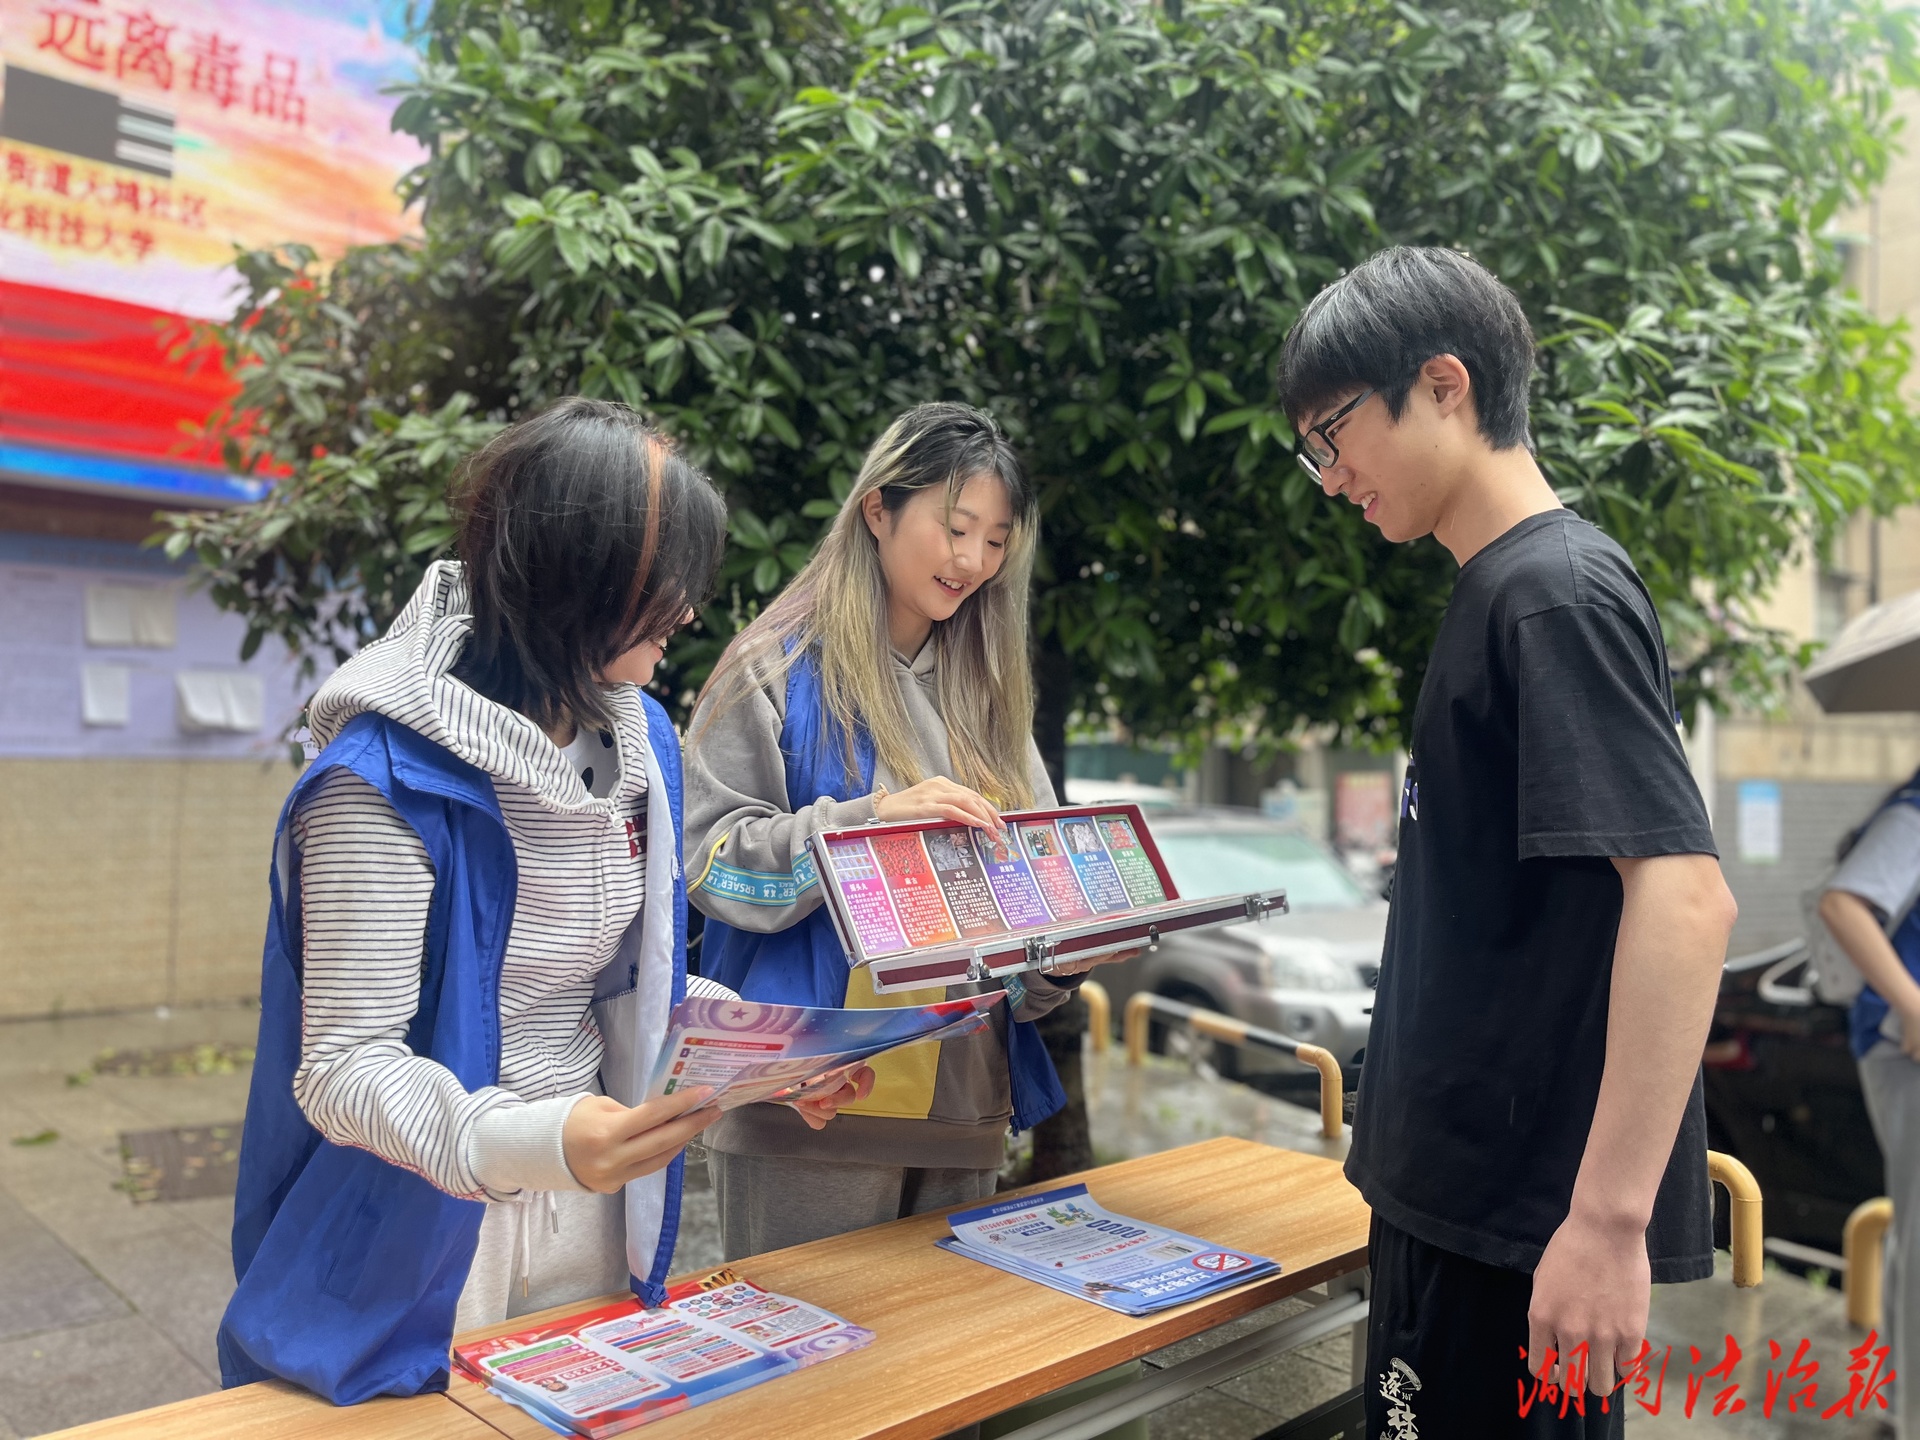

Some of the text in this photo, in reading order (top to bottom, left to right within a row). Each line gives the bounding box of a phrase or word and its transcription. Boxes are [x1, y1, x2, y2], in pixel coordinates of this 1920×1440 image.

[37, 9, 308, 124] 远离毒品
[562, 1360, 616, 1379] 12339
